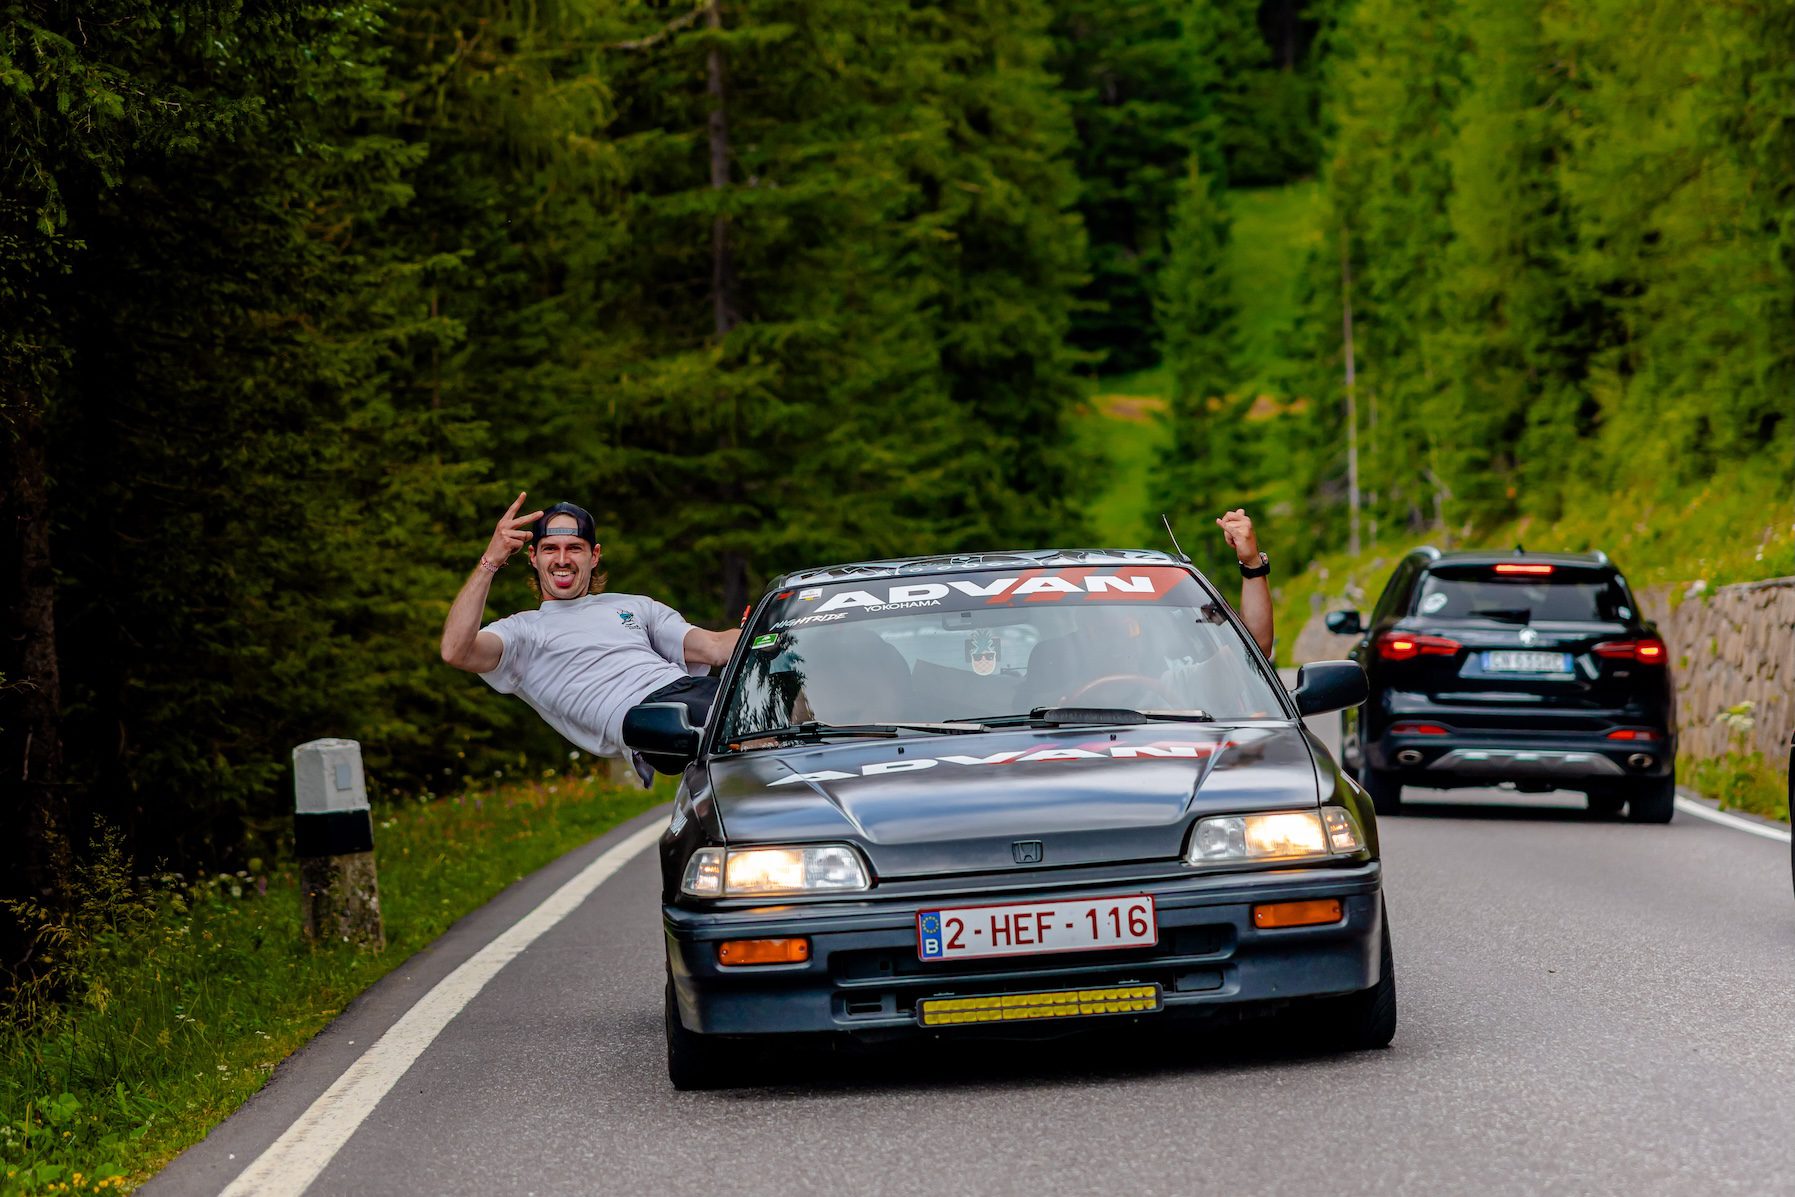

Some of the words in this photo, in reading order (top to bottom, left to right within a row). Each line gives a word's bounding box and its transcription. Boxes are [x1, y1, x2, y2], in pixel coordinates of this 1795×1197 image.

[813, 575, 1155, 614] ADVAN
[863, 598, 941, 614] YOKOHAMA
[769, 612, 848, 632] NIGHTRIDE
[766, 746, 1198, 787] ADVAN
[925, 938, 939, 954] B
